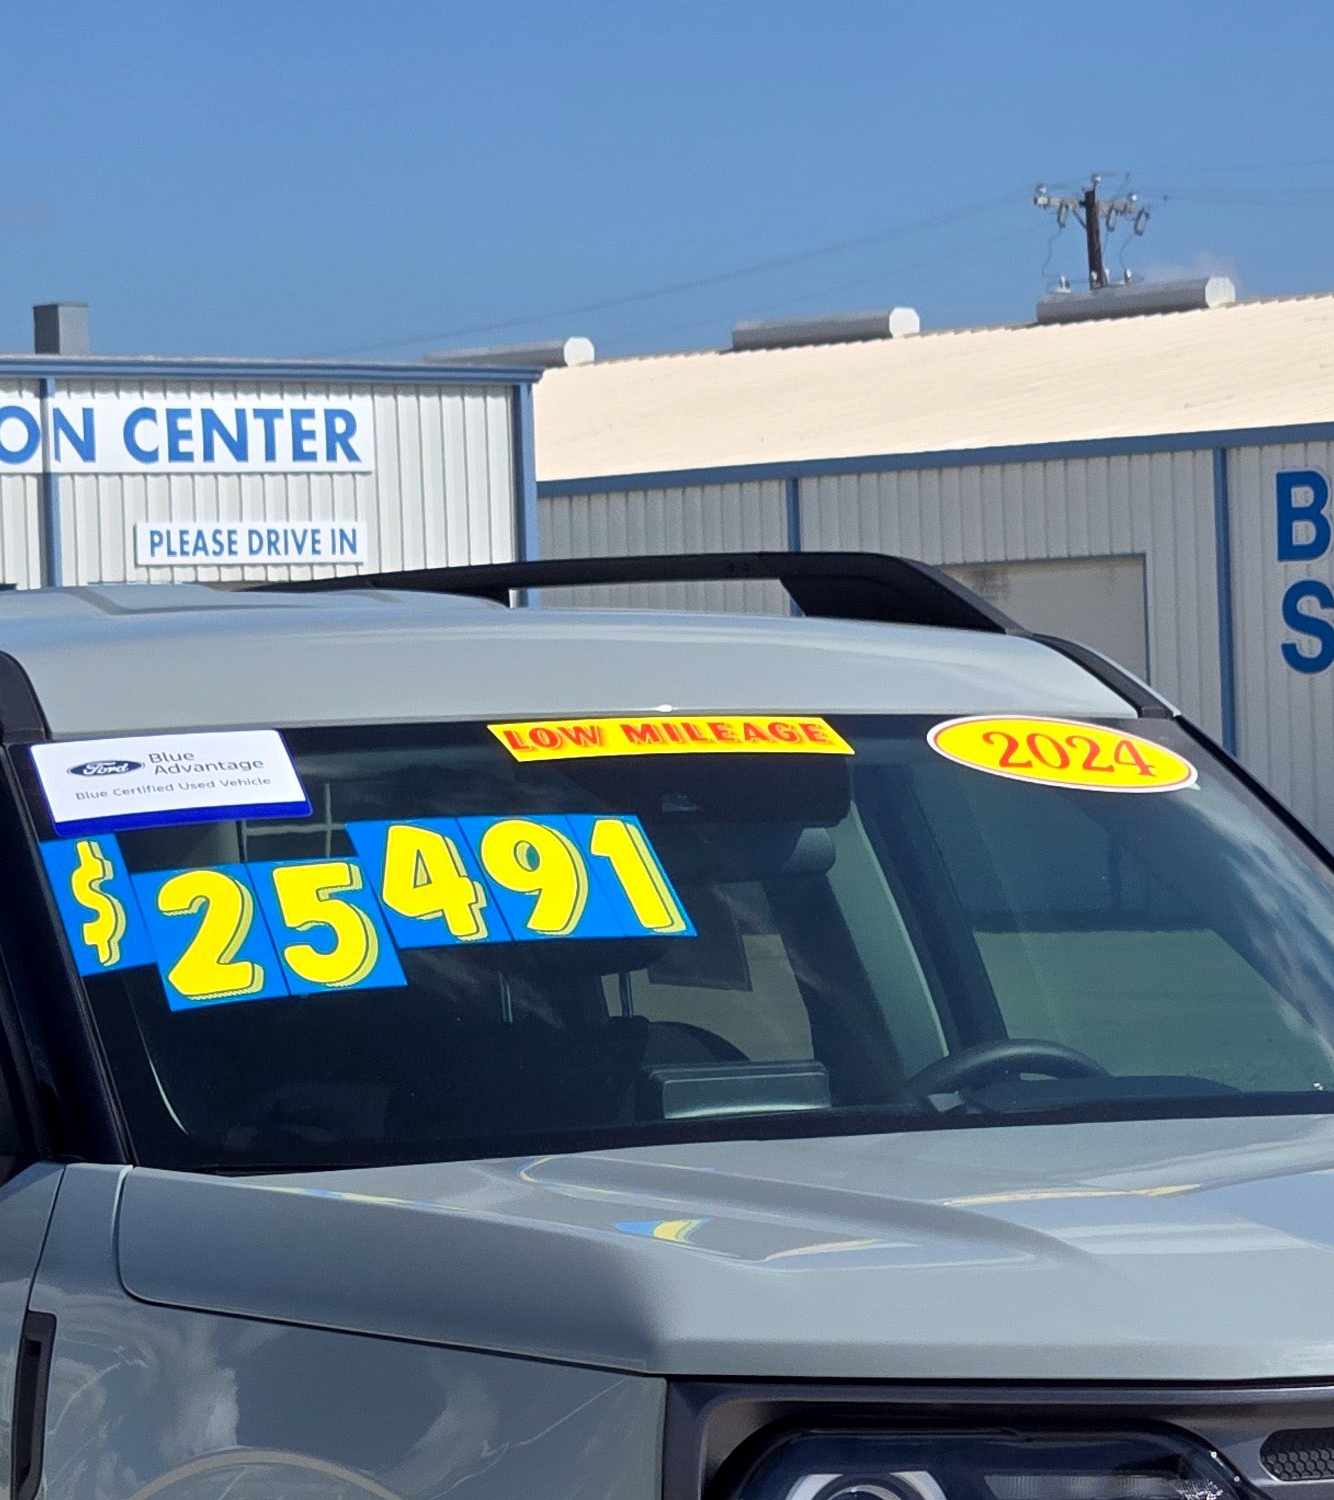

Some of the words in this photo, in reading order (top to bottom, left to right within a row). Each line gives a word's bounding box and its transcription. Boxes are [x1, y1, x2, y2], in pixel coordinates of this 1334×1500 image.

[122, 405, 362, 464] CENTER
[149, 529, 238, 557] PLEASE
[248, 528, 322, 556] DRIVE
[331, 528, 358, 555] IN
[503, 725, 602, 751] LOW
[620, 722, 830, 745] MILEAGE
[148, 751, 196, 764] Blue
[154, 758, 265, 775] Advantage
[982, 731, 1157, 777] 2024
[75, 790, 109, 801] Blue
[113, 783, 175, 797] Certified
[178, 779, 216, 791] Used
[220, 776, 271, 788] Vehicle
